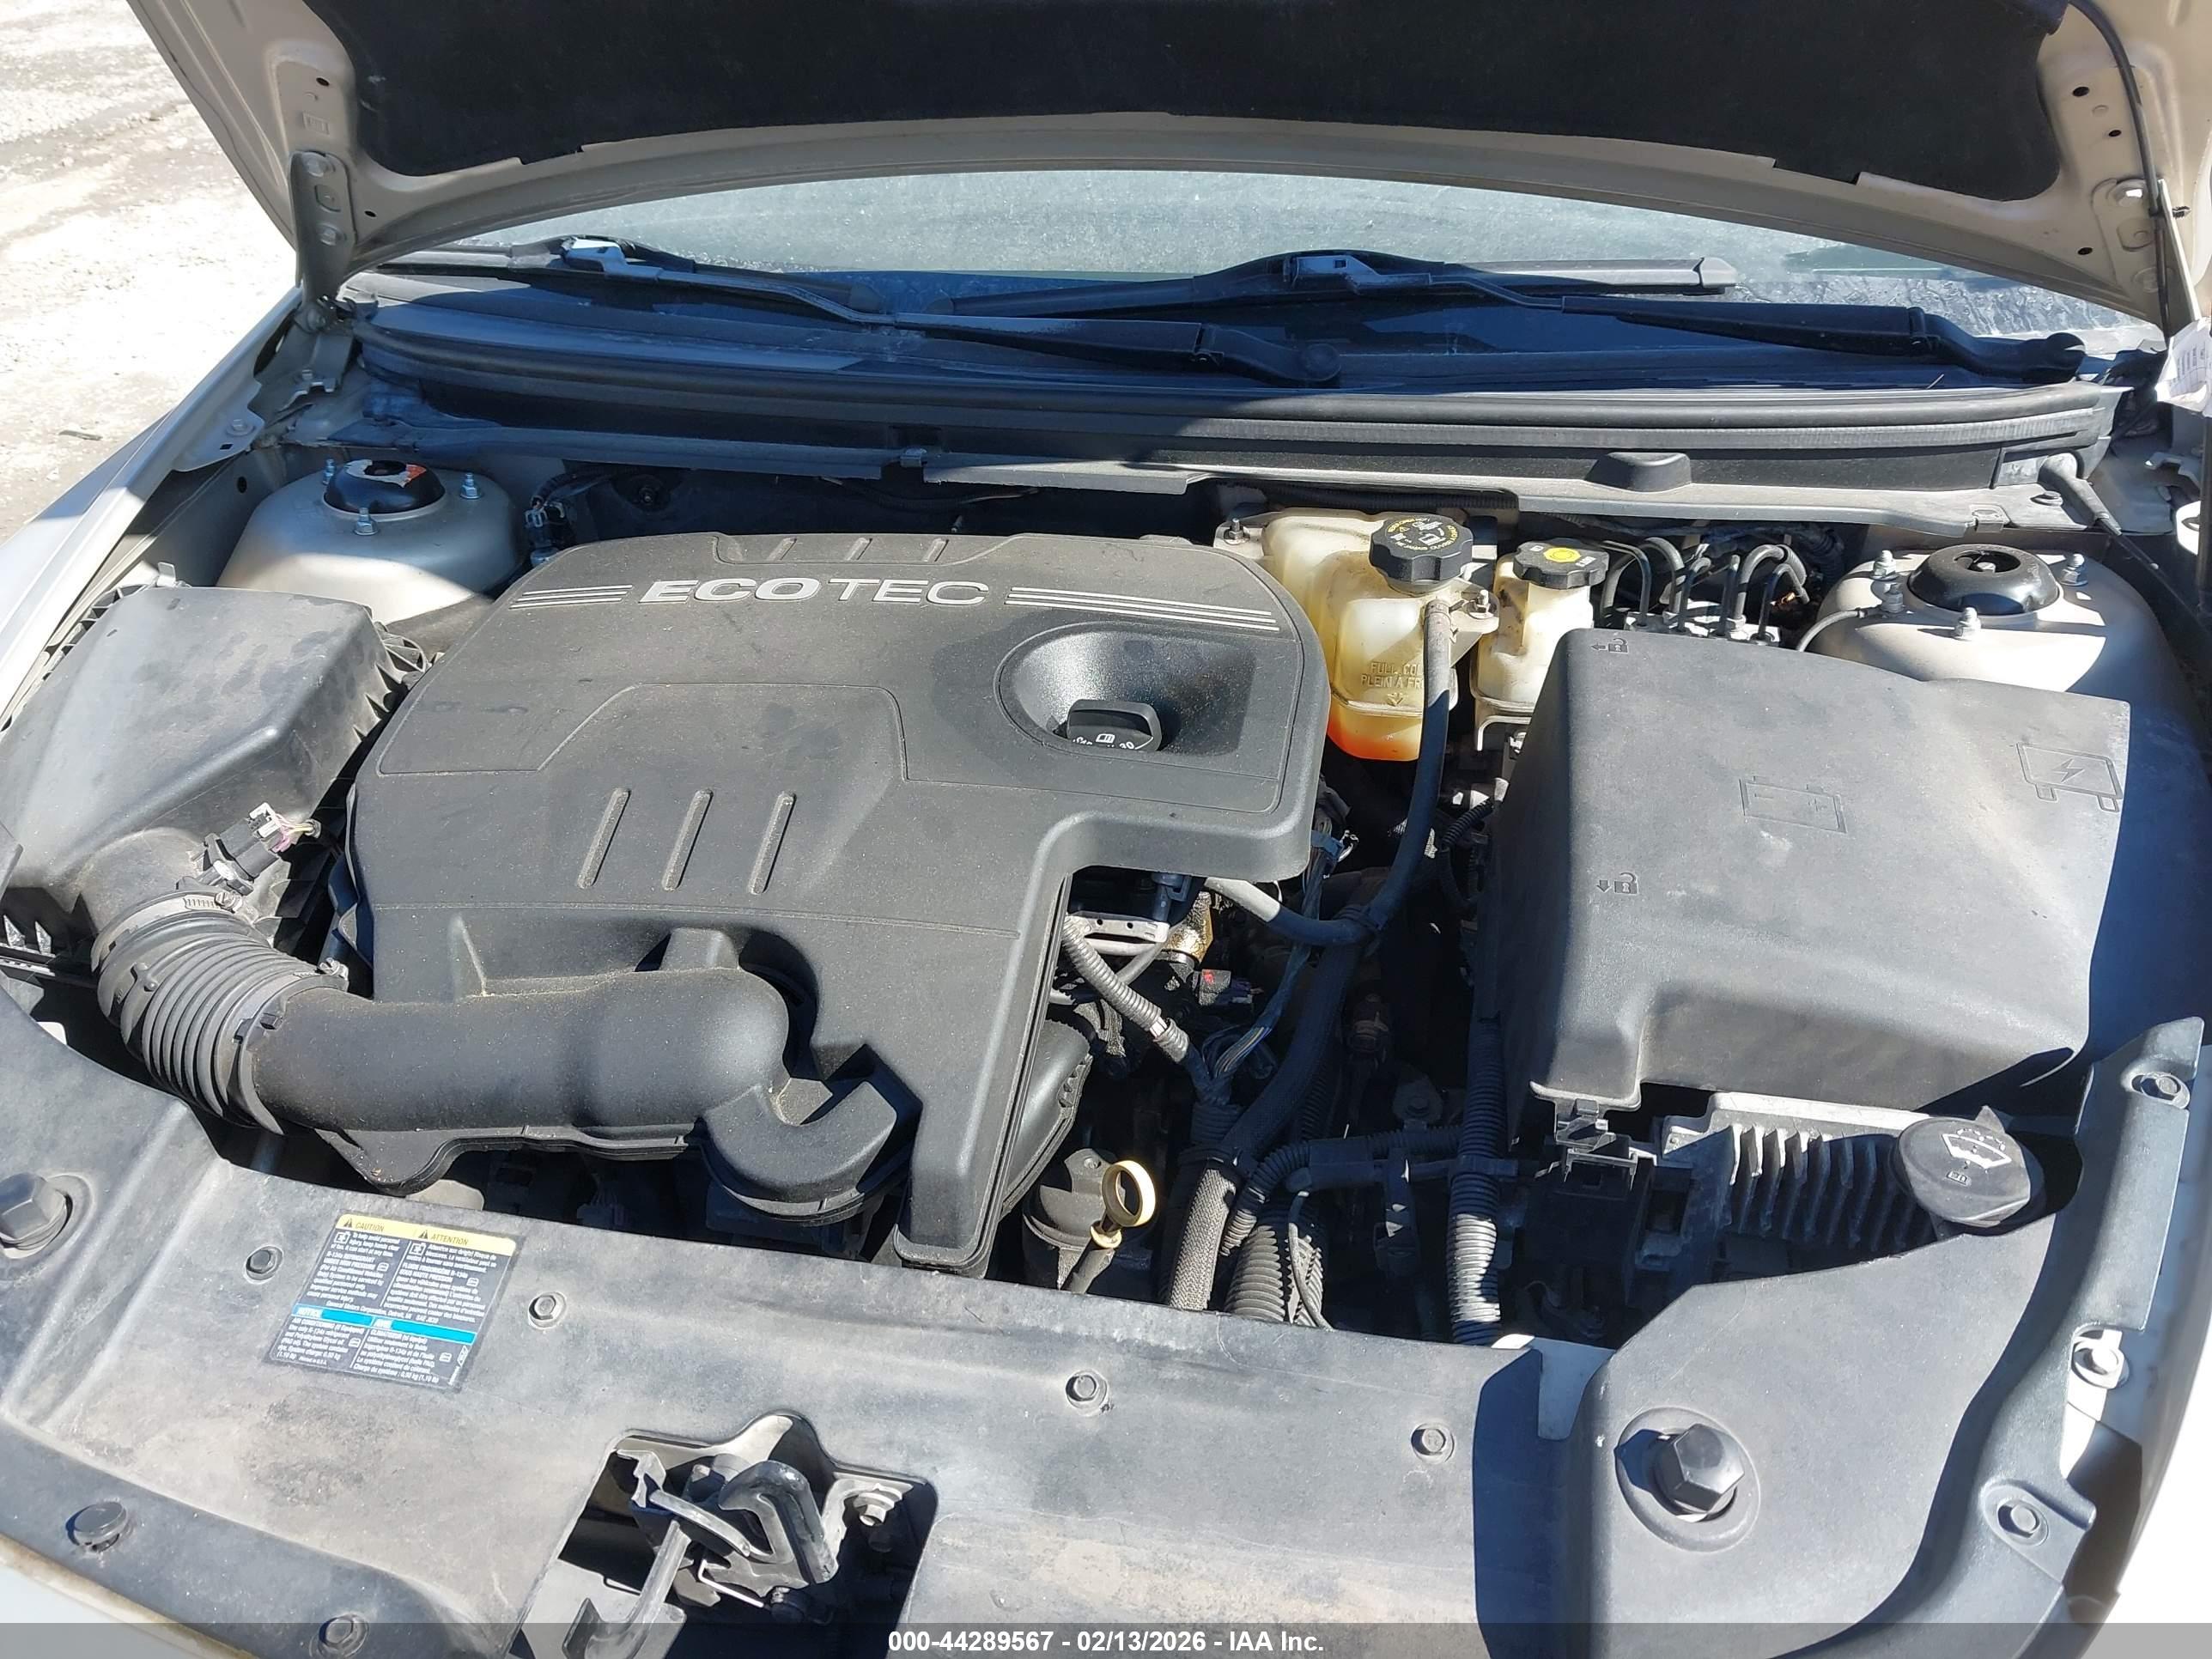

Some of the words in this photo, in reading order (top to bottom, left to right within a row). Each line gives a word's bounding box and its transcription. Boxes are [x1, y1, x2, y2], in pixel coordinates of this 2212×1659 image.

[639, 577, 989, 605] ECOTEC
[1370, 661, 1398, 675] FULL
[1361, 674, 1393, 688] PLEIN
[355, 1222, 385, 1232] CAUTION
[430, 1233, 469, 1246] ATTENTION
